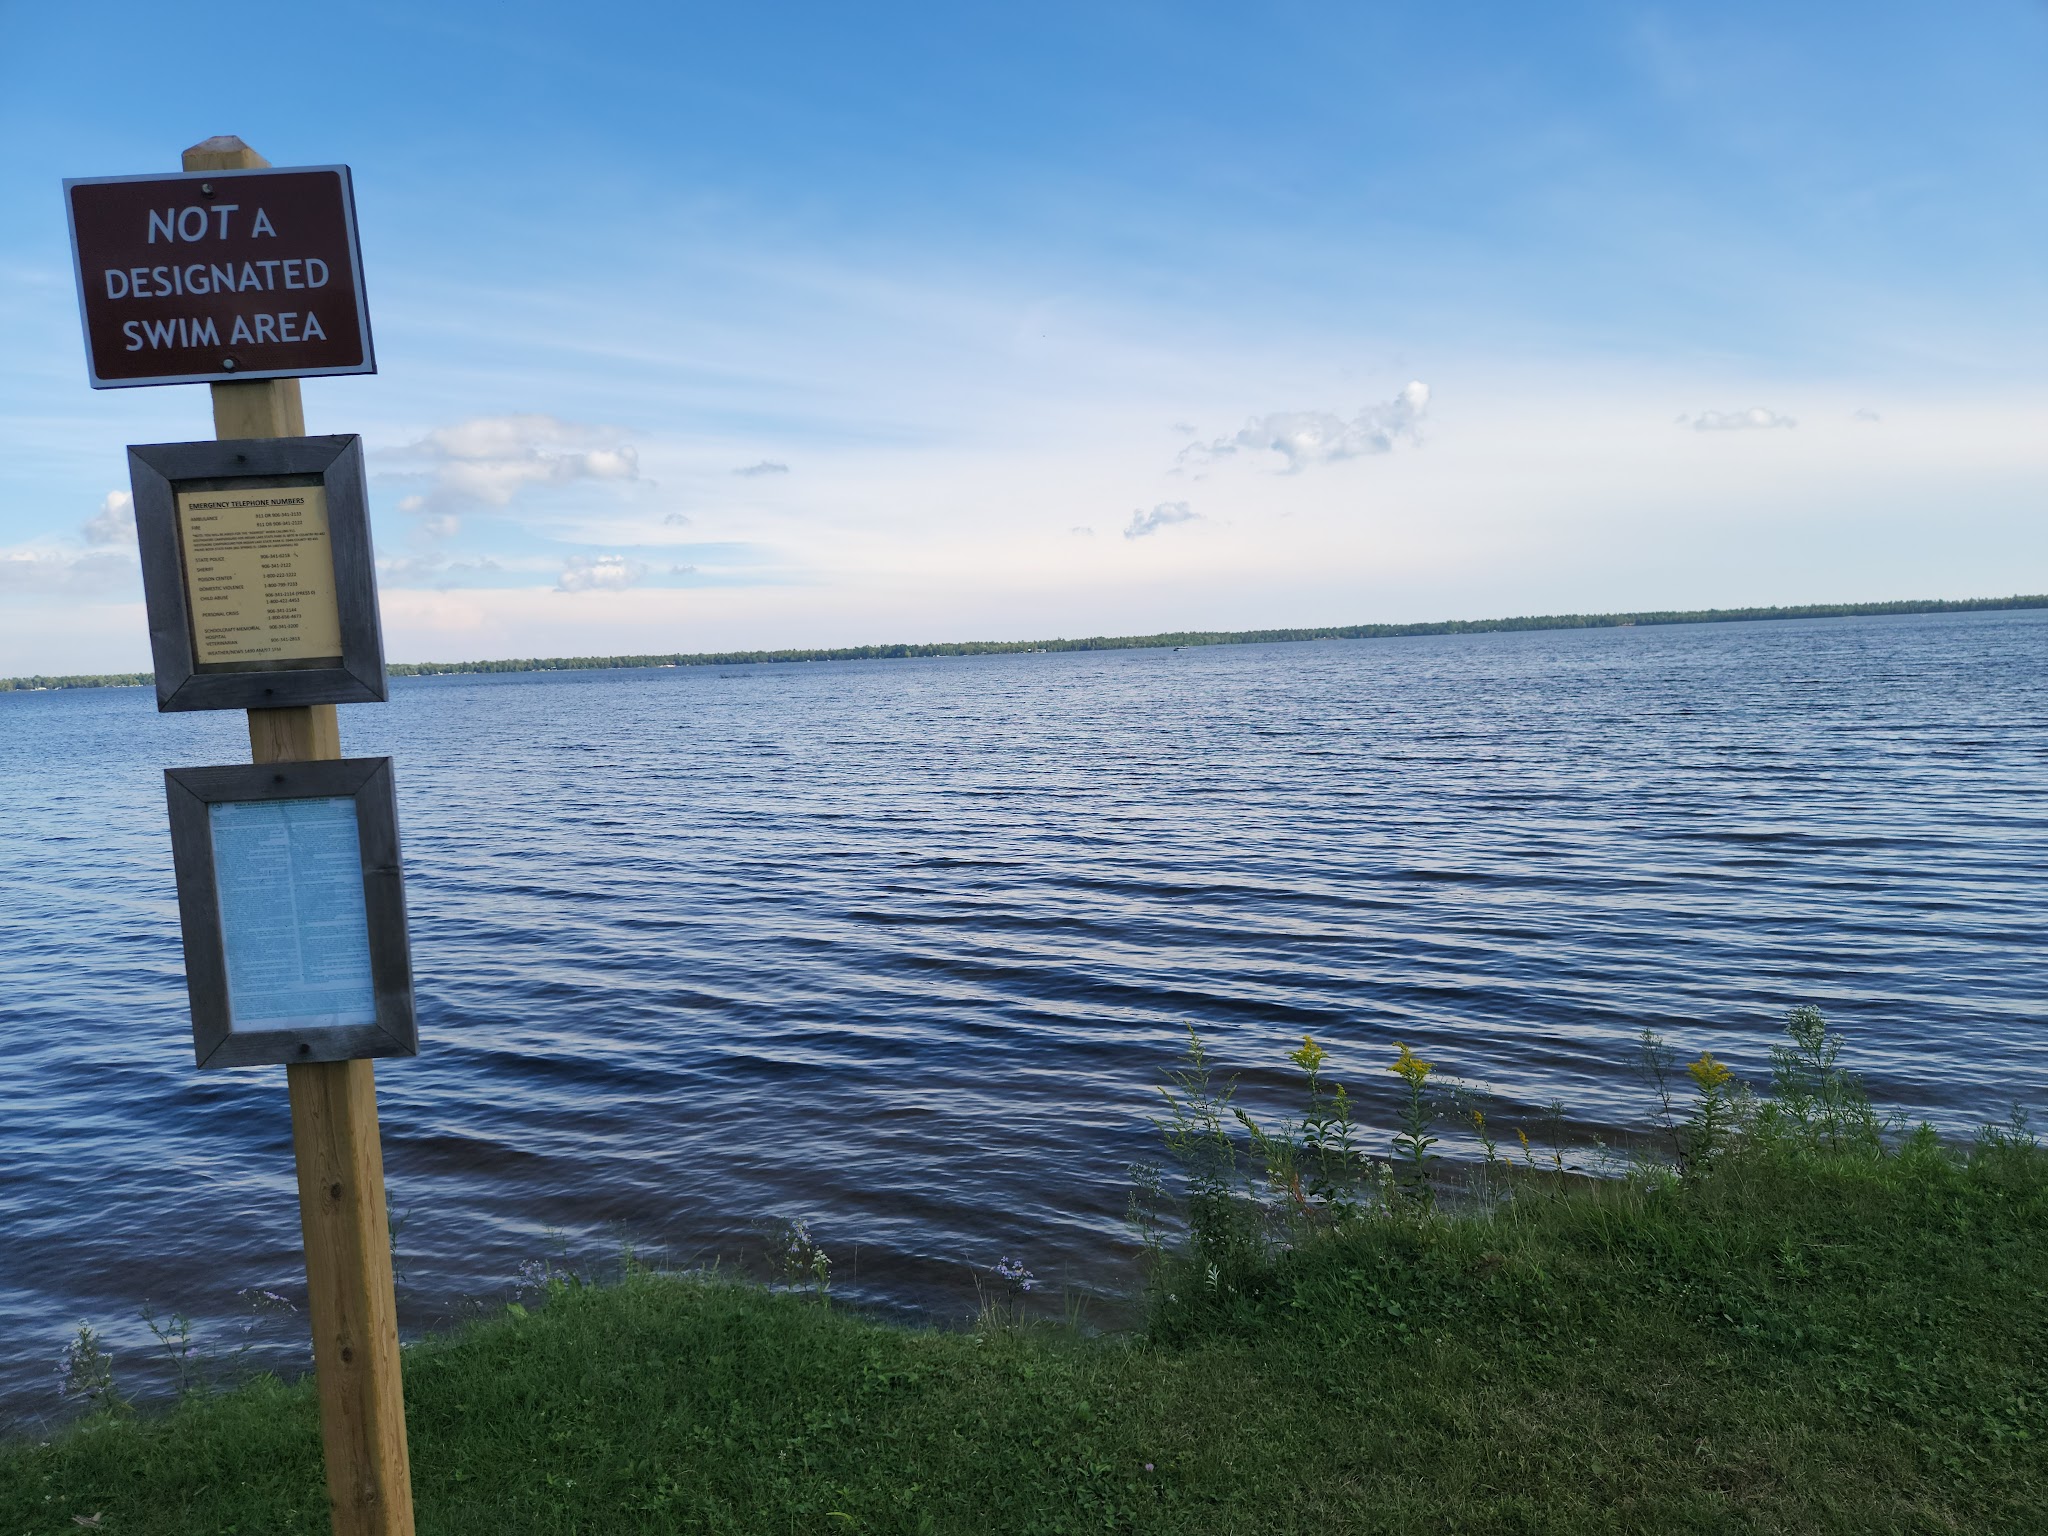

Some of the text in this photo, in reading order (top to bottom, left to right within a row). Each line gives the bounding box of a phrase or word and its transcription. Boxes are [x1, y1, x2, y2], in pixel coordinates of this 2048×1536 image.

[148, 204, 277, 244] NOT A
[105, 258, 329, 299] DESIGNATED
[122, 311, 327, 351] SWIM AREA
[188, 497, 305, 509] EMERGENCY TELEPHONE NUMBERS
